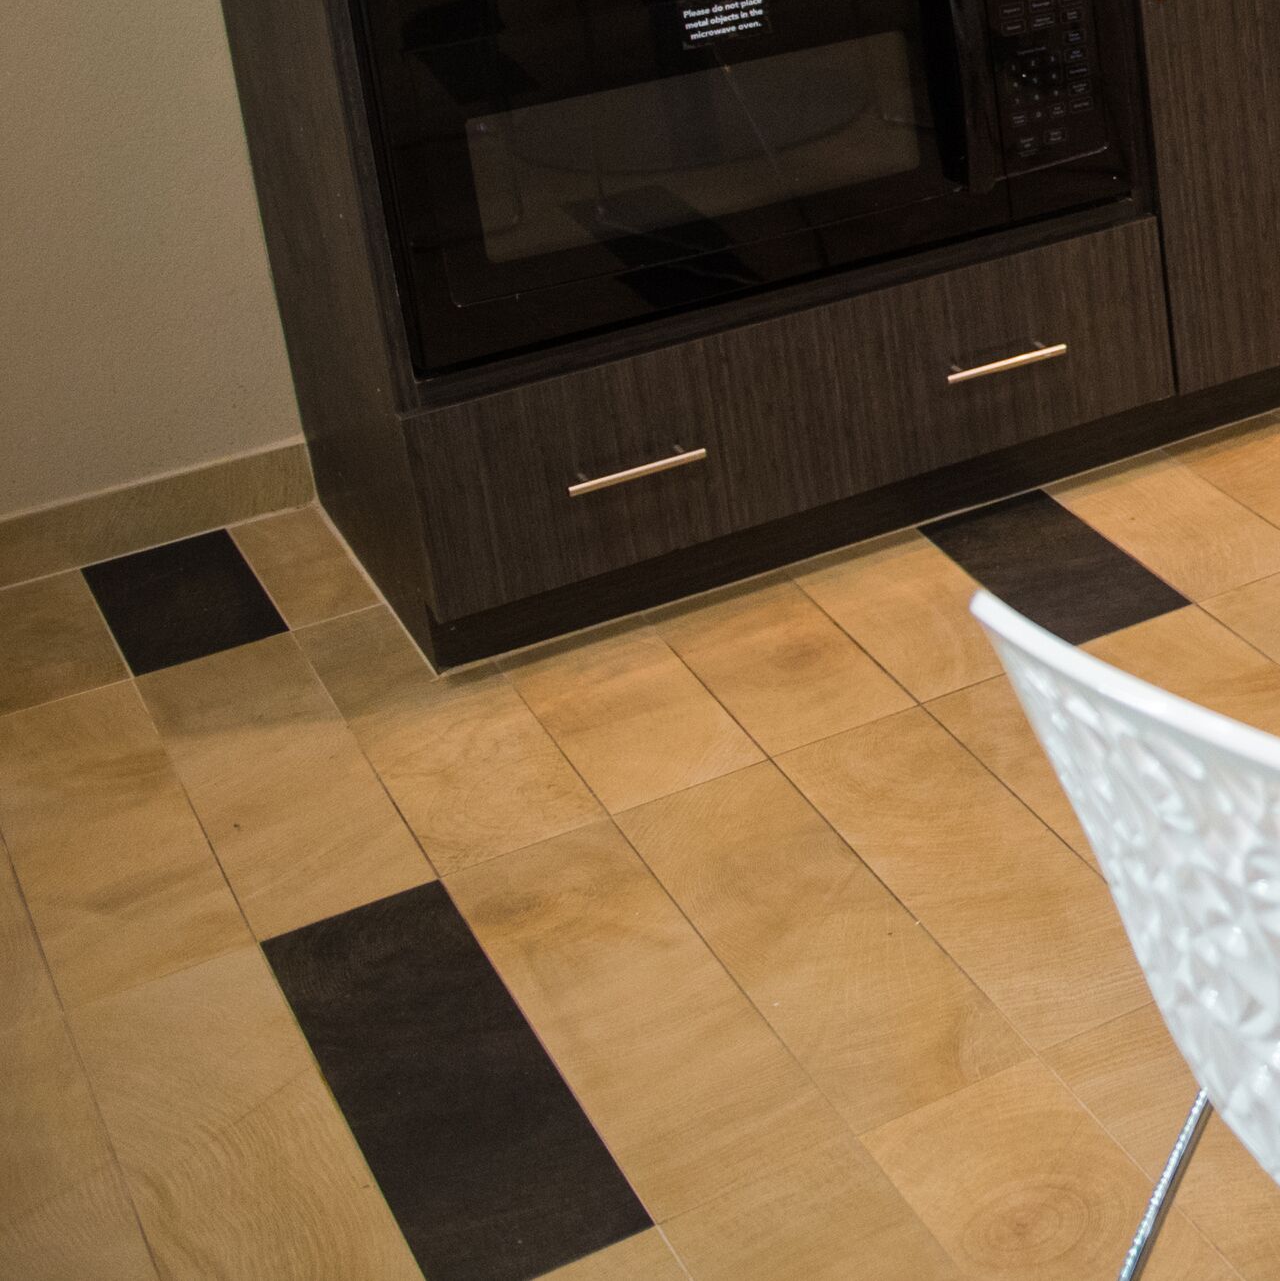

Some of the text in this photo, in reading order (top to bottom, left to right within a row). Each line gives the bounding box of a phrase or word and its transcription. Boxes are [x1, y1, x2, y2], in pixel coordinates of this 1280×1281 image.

[682, 7, 711, 19] Please
[711, 4, 724, 13] do
[724, 1, 740, 11] not
[685, 8, 764, 31] metal objects in the
[690, 21, 763, 41] microwave oven.
